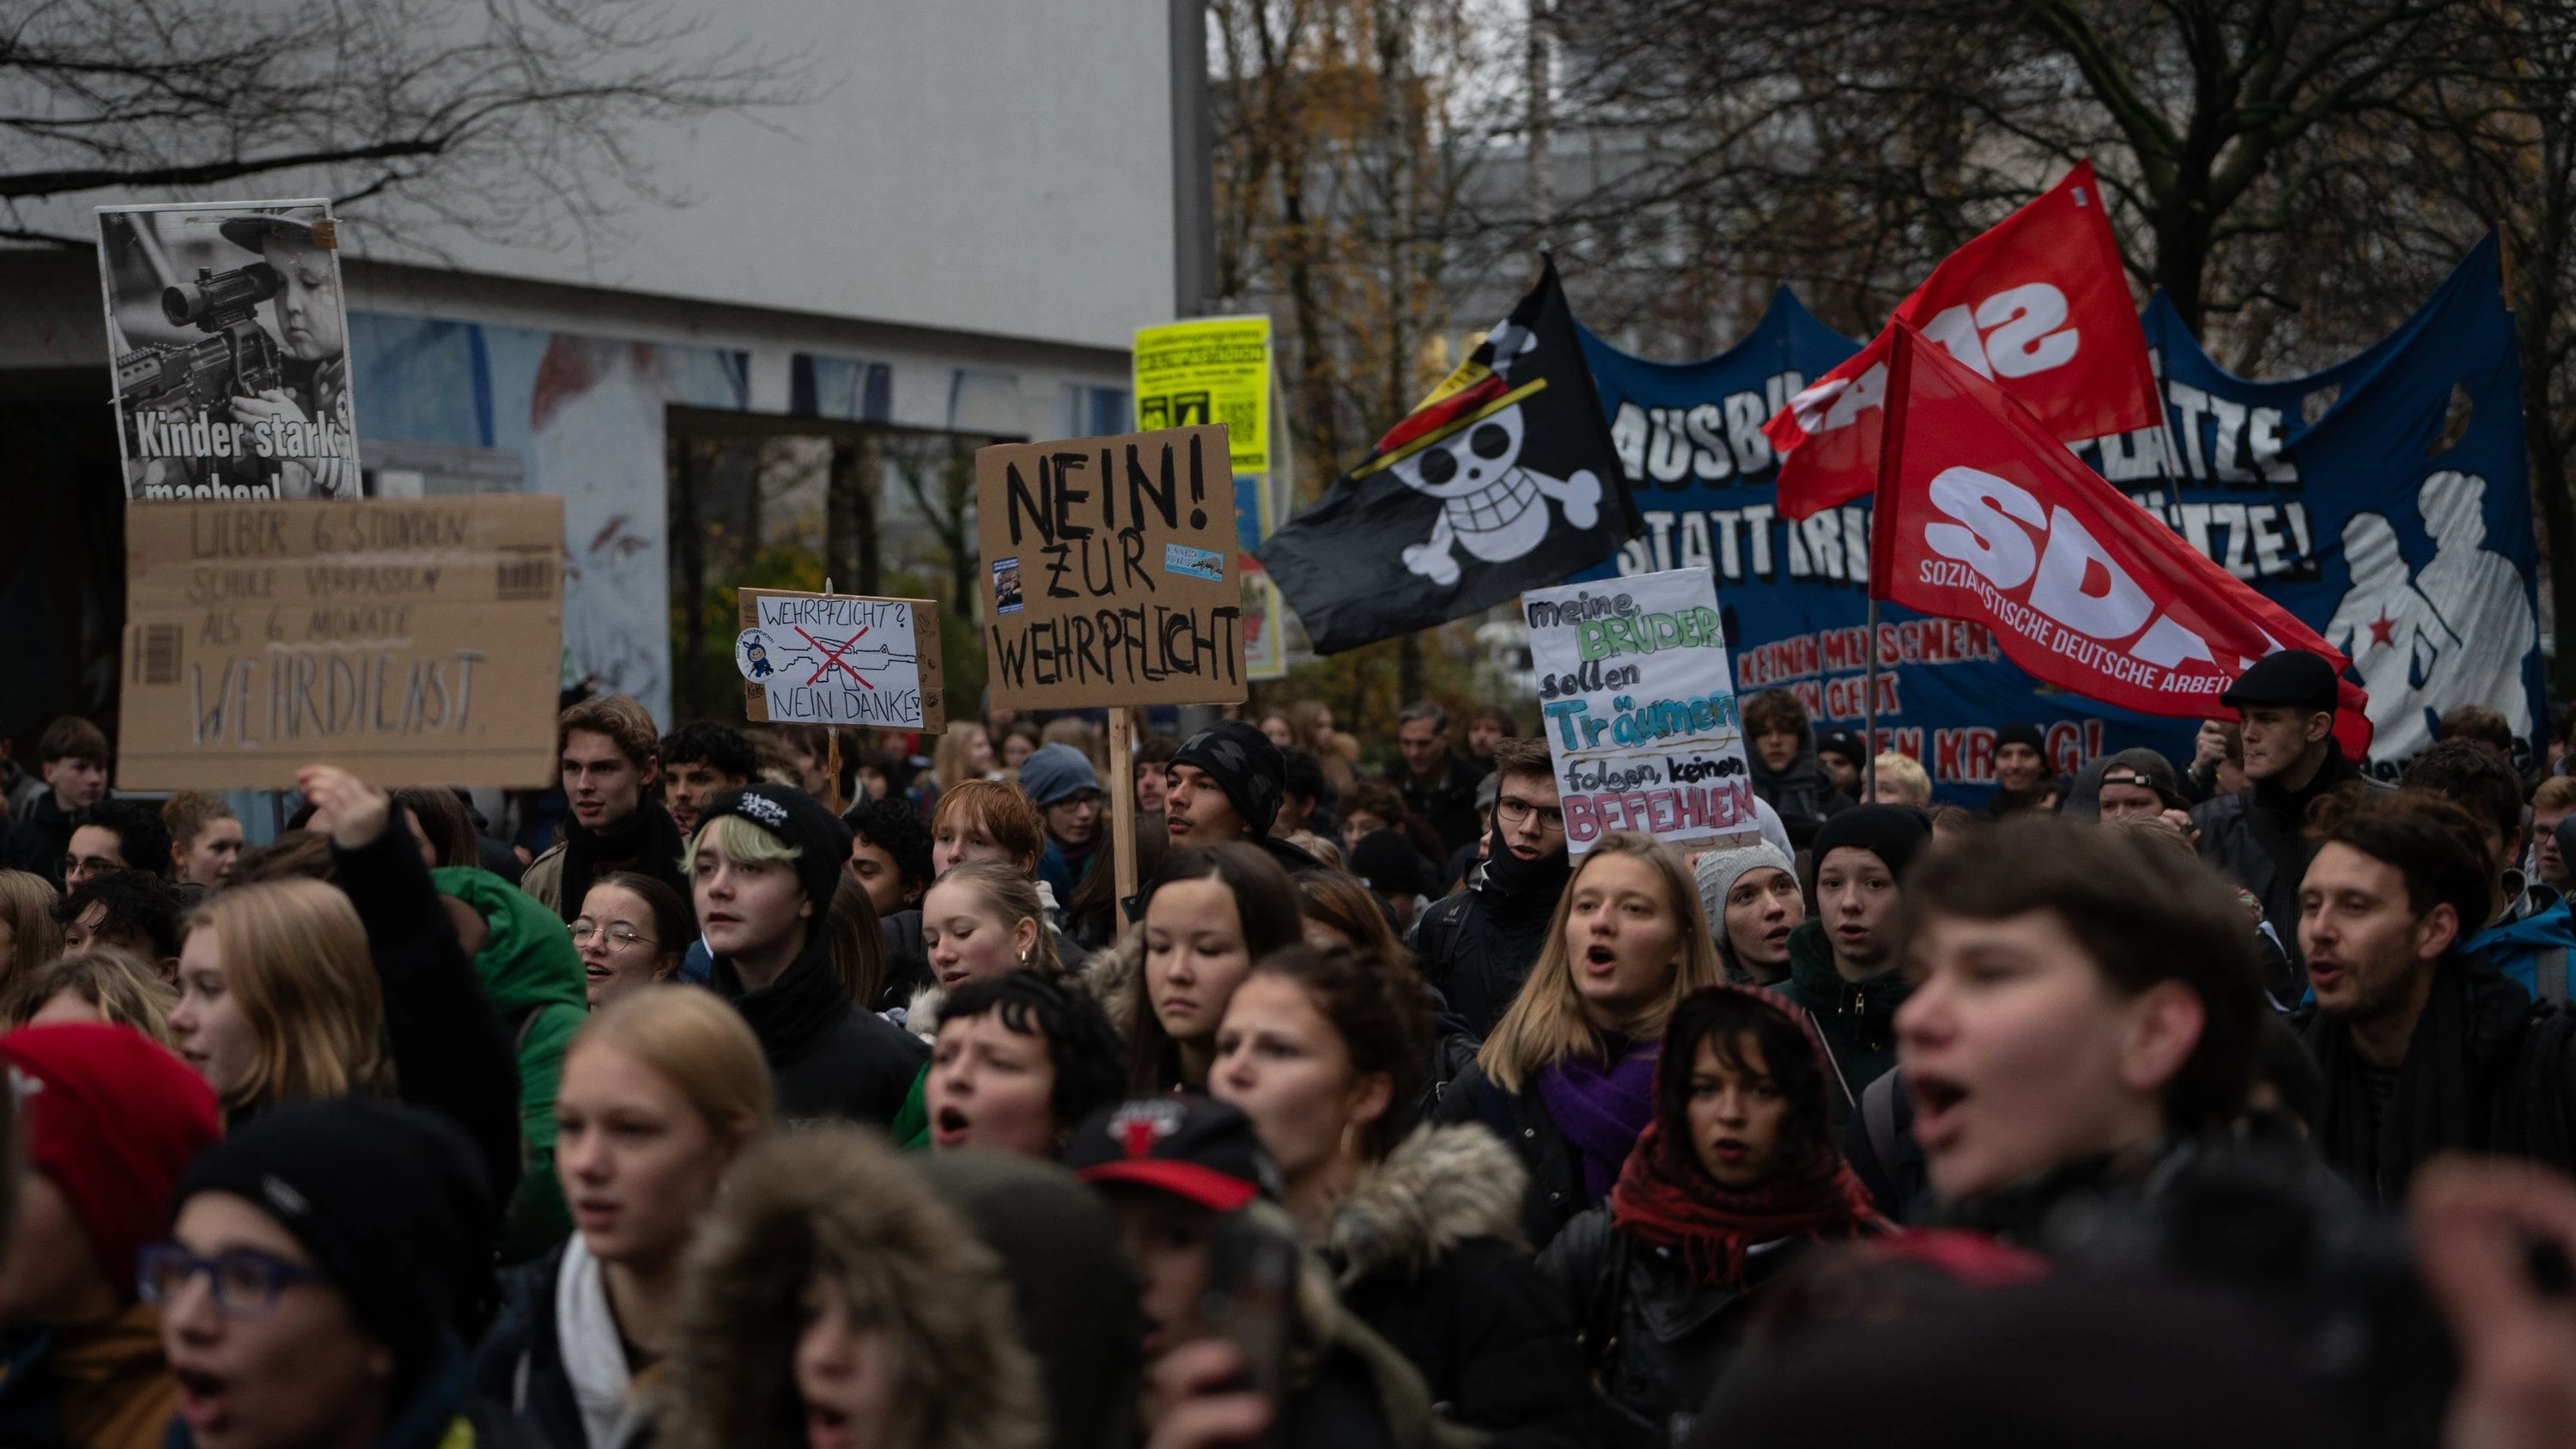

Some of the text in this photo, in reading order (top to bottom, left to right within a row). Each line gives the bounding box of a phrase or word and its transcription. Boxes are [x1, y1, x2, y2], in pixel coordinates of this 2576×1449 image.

[136, 410, 341, 458] Kinder stark
[1006, 433, 1207, 546] NEIN!
[191, 508, 470, 558] LIEBER 6 STUNDEN
[187, 565, 442, 602] SCHULE VERPASSEN
[1040, 527, 1156, 599] ZUR
[200, 604, 413, 644] ALS 6 MONATE
[1528, 591, 1633, 629] meine
[1575, 605, 1723, 662] BRÜDER
[1919, 558, 2052, 646] SOZIAISTISCHE
[2051, 628, 2159, 689] DEUTSCHE
[992, 603, 1242, 690] WEHRPFLICHT
[1736, 633, 1822, 690] KEINEN
[773, 687, 921, 722] NEIN DANKE!
[1540, 660, 1641, 699] sollen
[1545, 690, 1741, 751] Träumen
[1564, 756, 1744, 794] folgen, keinen
[1561, 777, 1759, 842] BEFEHLEN
